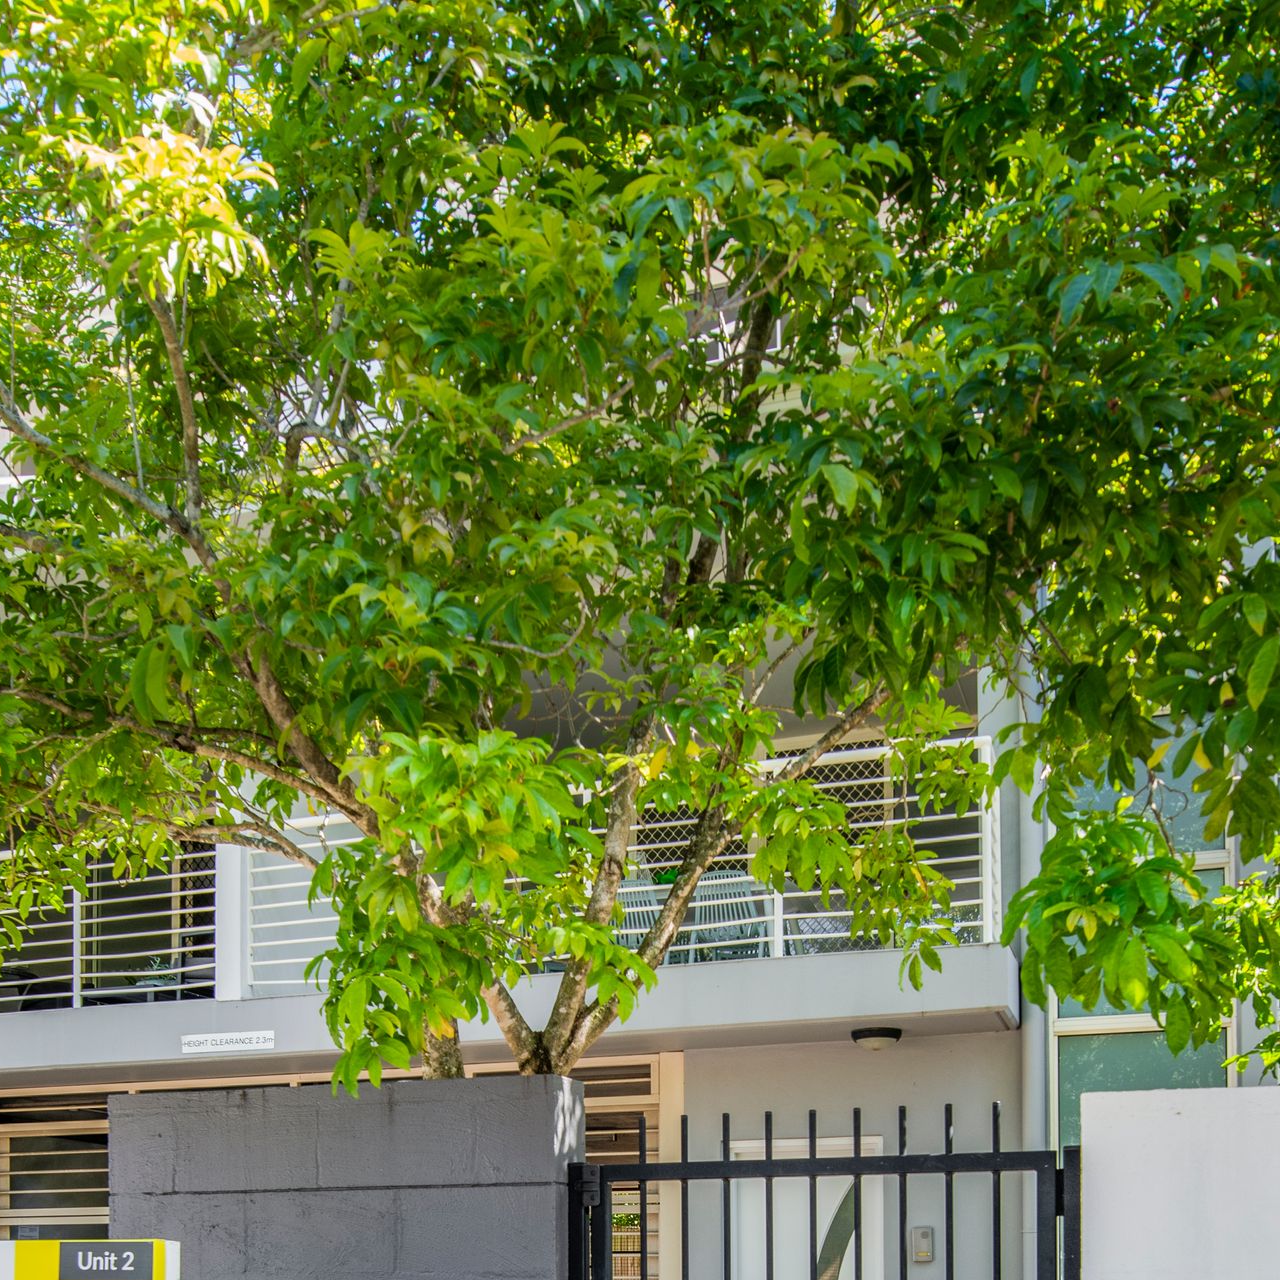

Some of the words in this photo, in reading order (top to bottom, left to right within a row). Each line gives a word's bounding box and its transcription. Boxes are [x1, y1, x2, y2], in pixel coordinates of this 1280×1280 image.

[183, 1039, 209, 1048] HEIGHT
[210, 1037, 254, 1047] CLEARANCE
[77, 1250, 118, 1272] Unit
[121, 1251, 136, 1272] 2
